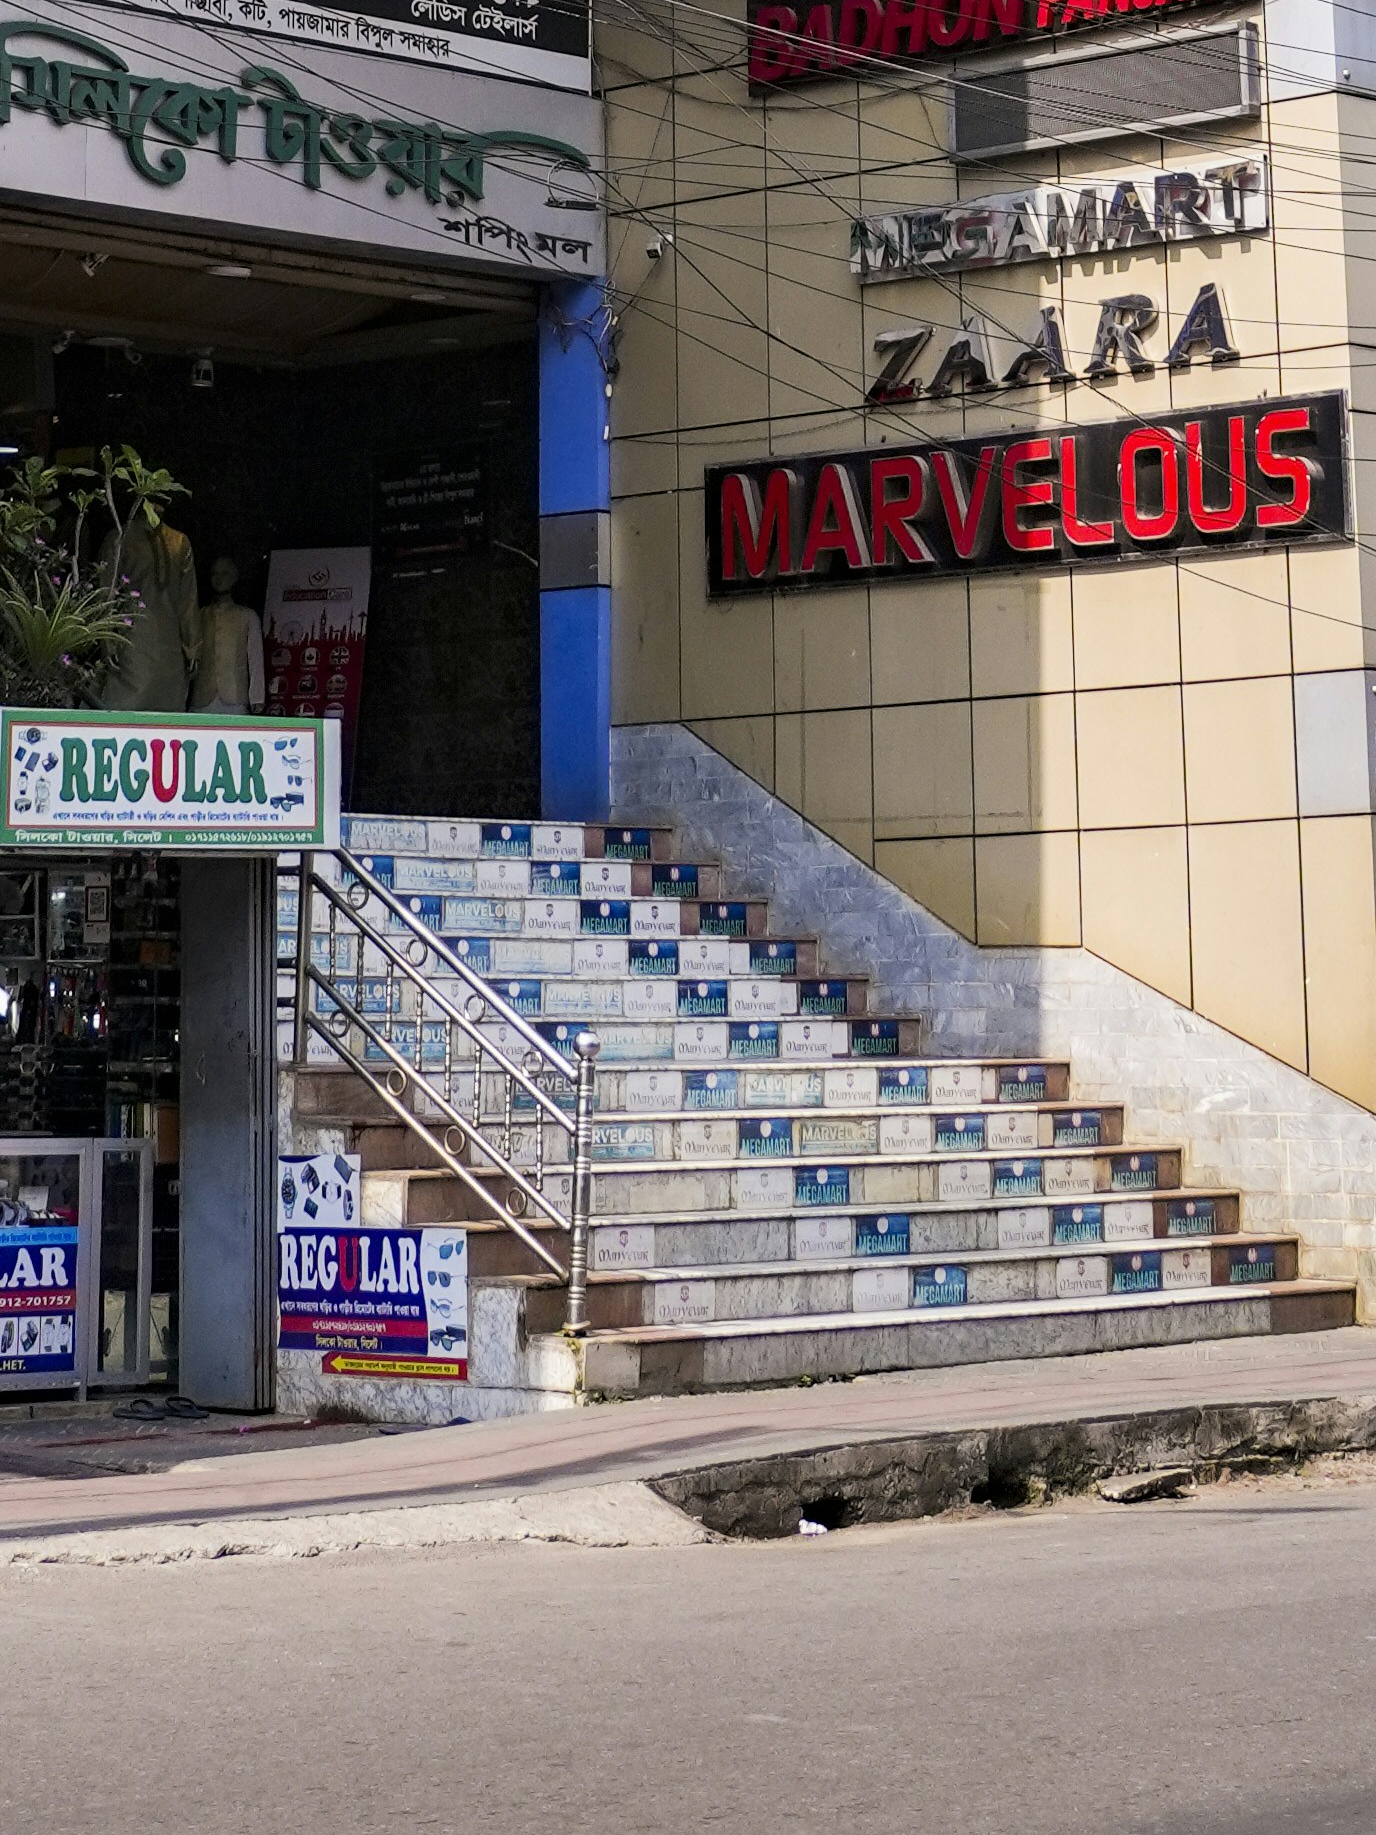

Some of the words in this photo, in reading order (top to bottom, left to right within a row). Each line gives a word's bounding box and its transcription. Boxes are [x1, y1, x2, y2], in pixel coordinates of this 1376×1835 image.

[278, 5, 351, 41] পায়জামার
[354, 17, 395, 52] বিপুল
[471, 1, 538, 42] টেইলার্স
[243, 66, 592, 207] টাওয়ার
[850, 160, 1265, 279] MEGAMART
[533, 232, 592, 265] মল
[866, 281, 1243, 404] ZAARA
[721, 408, 1312, 581] MARVELOUS
[59, 736, 268, 804] REGULAR
[483, 839, 530, 857] MEGAMART
[606, 843, 649, 860] MEGAMART
[533, 878, 580, 895] MEGAMART
[653, 881, 698, 898] MEGAMART
[582, 916, 629, 935] MEGAMART
[701, 918, 746, 936] MEGAMART
[631, 956, 677, 975] MEGAMART
[751, 958, 795, 975] MEGAMART
[680, 996, 726, 1015] MEGAMART
[801, 996, 846, 1015] MEGAMART
[731, 1038, 778, 1057] MEGAMART
[852, 1038, 898, 1056] MEGAMART
[687, 1087, 738, 1108] MEGAMART
[880, 1086, 928, 1105] MEGAMART
[999, 1085, 1045, 1103] MEGAMART
[936, 1132, 984, 1151] MEGAMART
[1054, 1127, 1100, 1146] MEGAMART
[742, 1137, 792, 1157] MEGAMART
[995, 1177, 1042, 1195] MEGAMART
[1112, 1170, 1158, 1190] MEGAMART
[798, 1184, 849, 1205] MEGAMART
[1054, 1222, 1102, 1243] MEGAMART
[1167, 1215, 1213, 1235] MEGAMART
[858, 1233, 909, 1254] MEGAMART
[279, 1234, 421, 1294] REGULAR
[1229, 1263, 1275, 1283] MEGAMART
[1113, 1270, 1160, 1291] MEGAMART
[915, 1284, 967, 1306] MEGAMART
